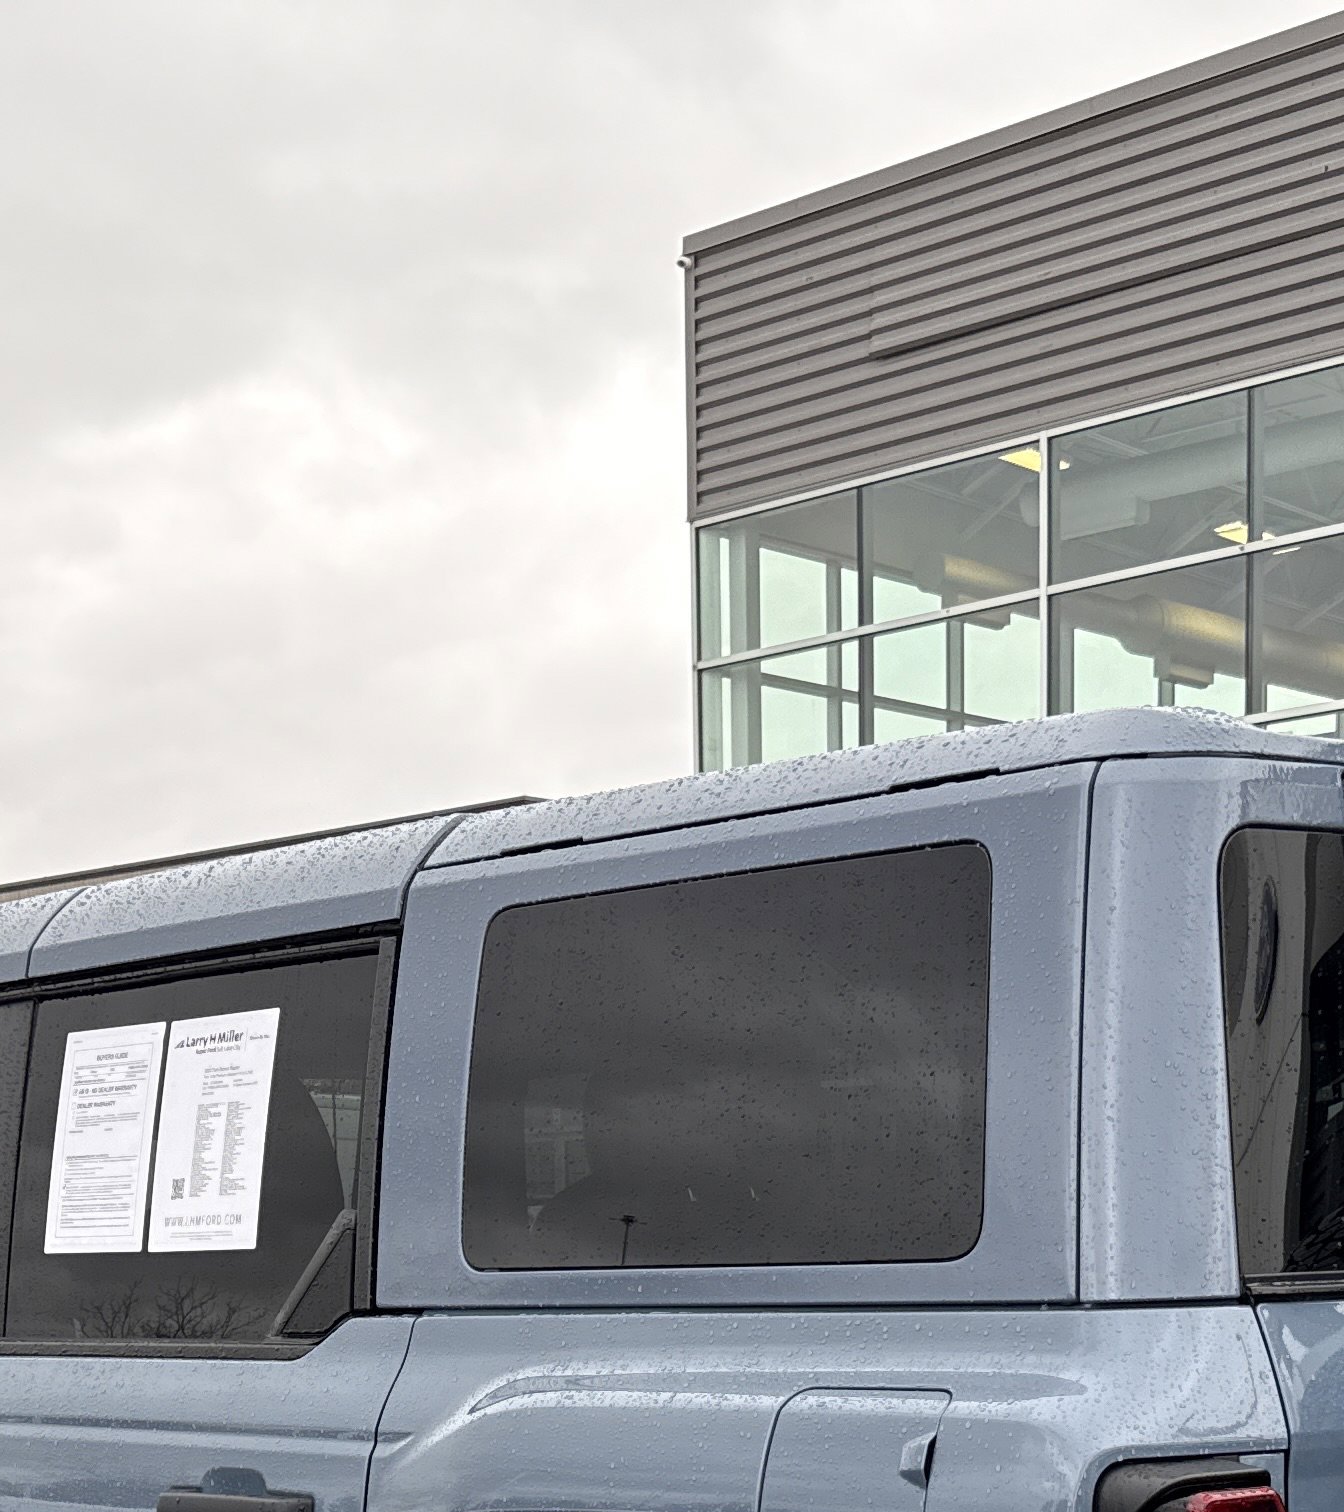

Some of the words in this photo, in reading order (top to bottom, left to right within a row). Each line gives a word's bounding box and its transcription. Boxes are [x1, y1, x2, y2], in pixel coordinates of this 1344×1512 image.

[186, 1035, 209, 1049] Larry
[209, 1033, 217, 1045] H
[217, 1029, 244, 1045] Miller
